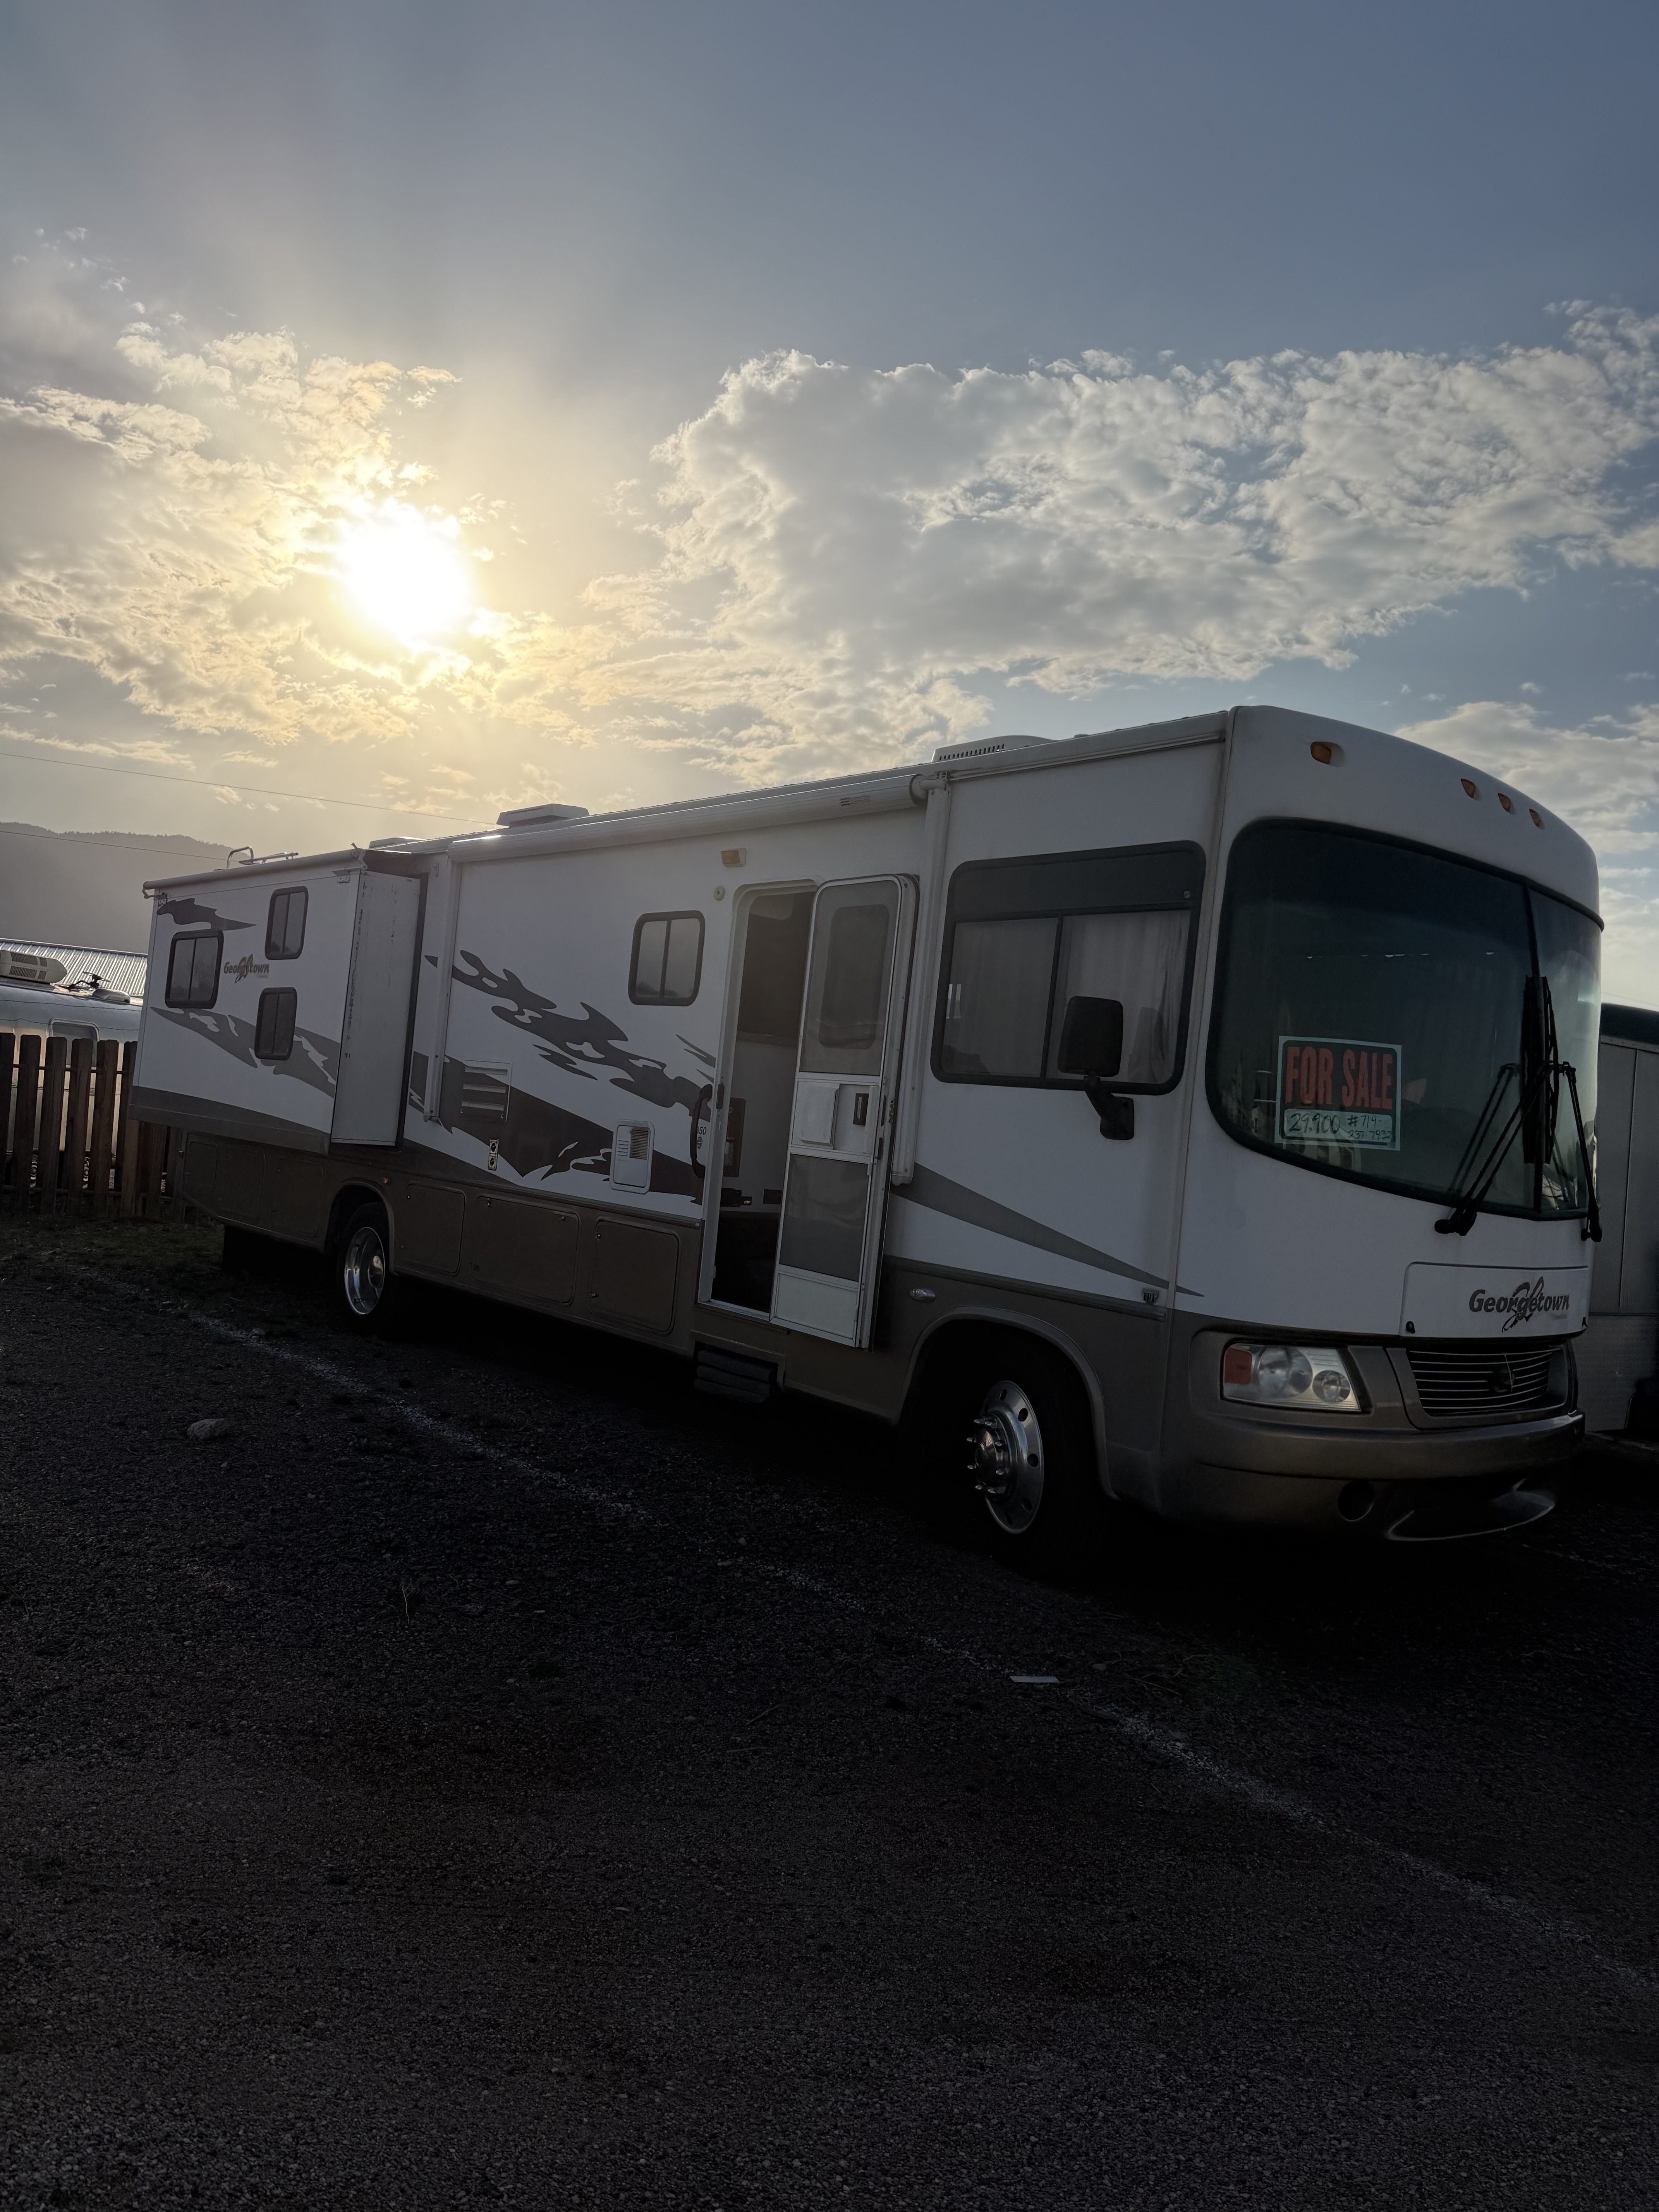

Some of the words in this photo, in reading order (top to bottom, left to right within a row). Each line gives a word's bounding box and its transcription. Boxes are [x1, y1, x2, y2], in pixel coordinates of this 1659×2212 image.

[1285, 1046, 1334, 1104] FOR
[1341, 1049, 1393, 1109] SALE
[1469, 1289, 1570, 1320] Georgetown
